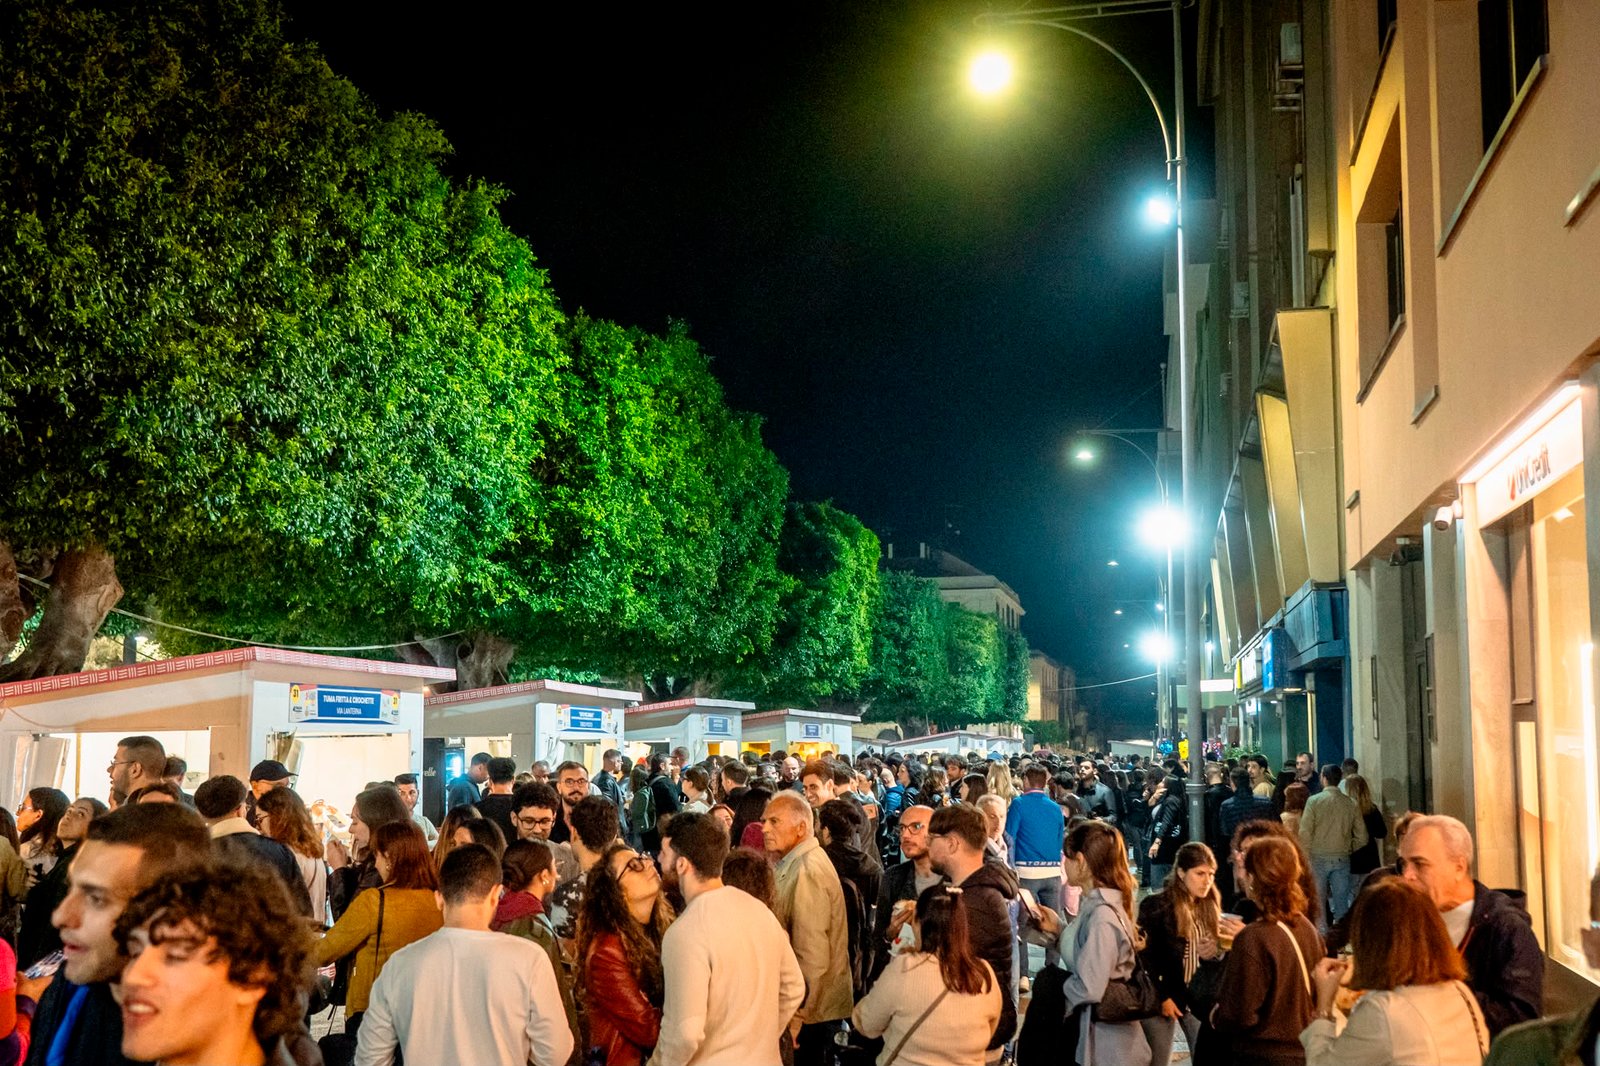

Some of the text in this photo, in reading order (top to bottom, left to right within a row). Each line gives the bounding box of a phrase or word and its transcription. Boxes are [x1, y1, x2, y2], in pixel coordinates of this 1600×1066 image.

[323, 695, 335, 703] TUMA
[336, 695, 349, 703] FRITTA
[343, 707, 362, 715] LANTERNA
